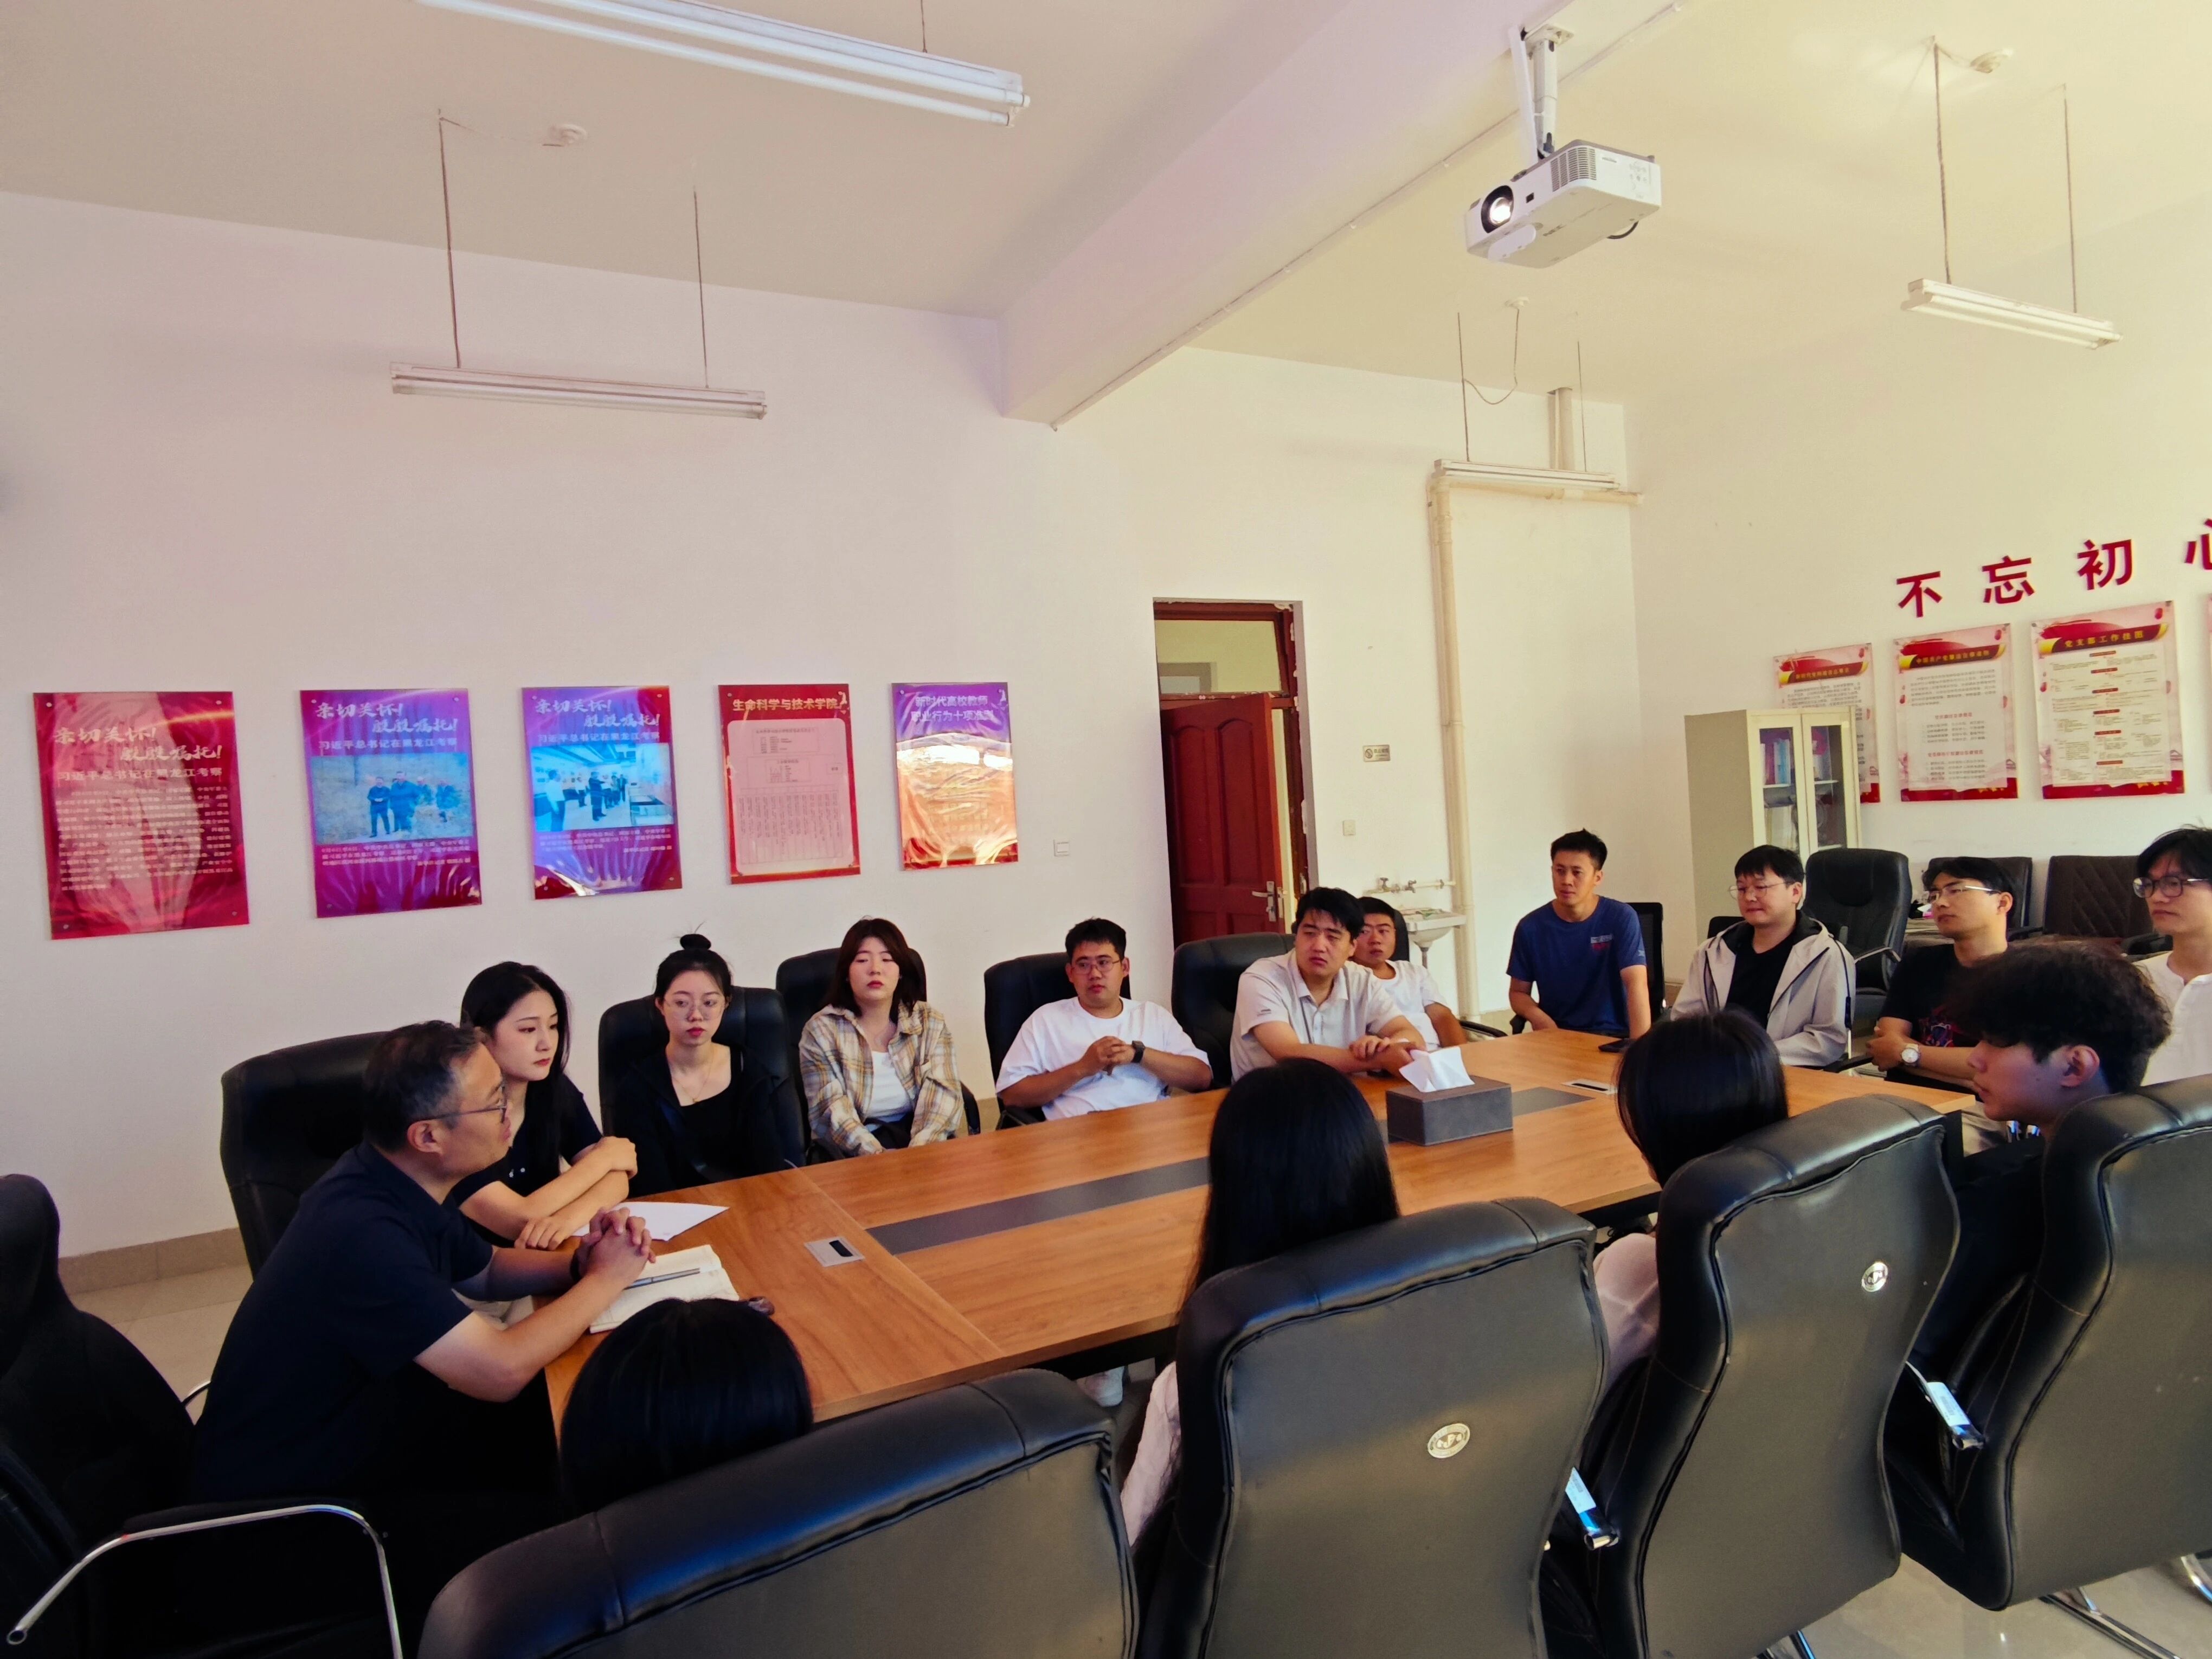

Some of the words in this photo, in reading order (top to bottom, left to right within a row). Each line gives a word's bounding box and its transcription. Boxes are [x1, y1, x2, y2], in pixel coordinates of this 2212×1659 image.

[732, 698, 838, 711] 生命科学与技术学院
[915, 695, 988, 707] 新时代高校教师
[911, 710, 994, 722] 职业行为十项准则
[319, 738, 458, 750] 习近平总书记在黑龙江考察
[58, 767, 222, 781] 习近平总书记在黑龙江考察
